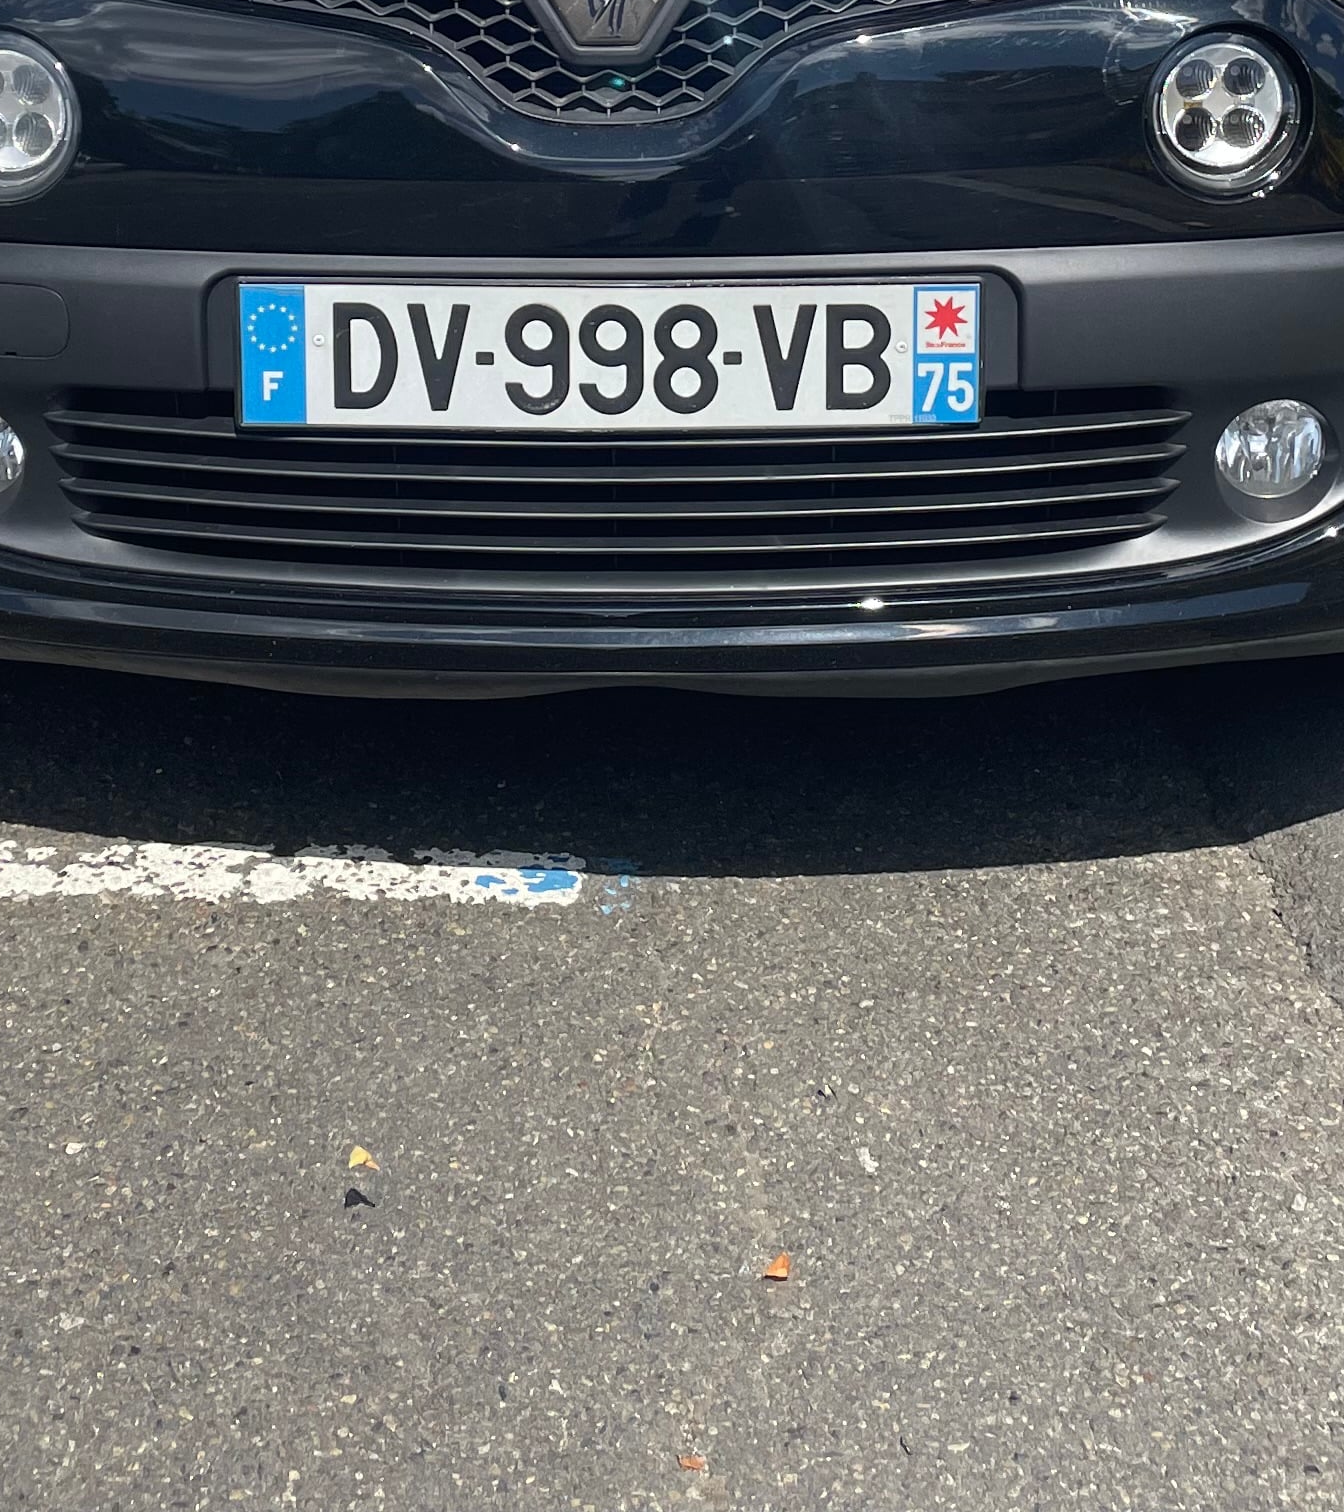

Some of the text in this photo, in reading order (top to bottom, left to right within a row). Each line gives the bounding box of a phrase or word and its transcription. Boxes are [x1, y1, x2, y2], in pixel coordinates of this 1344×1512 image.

[333, 302, 891, 416] DV-998-VB
[263, 371, 284, 401] F
[917, 362, 974, 412] 75
